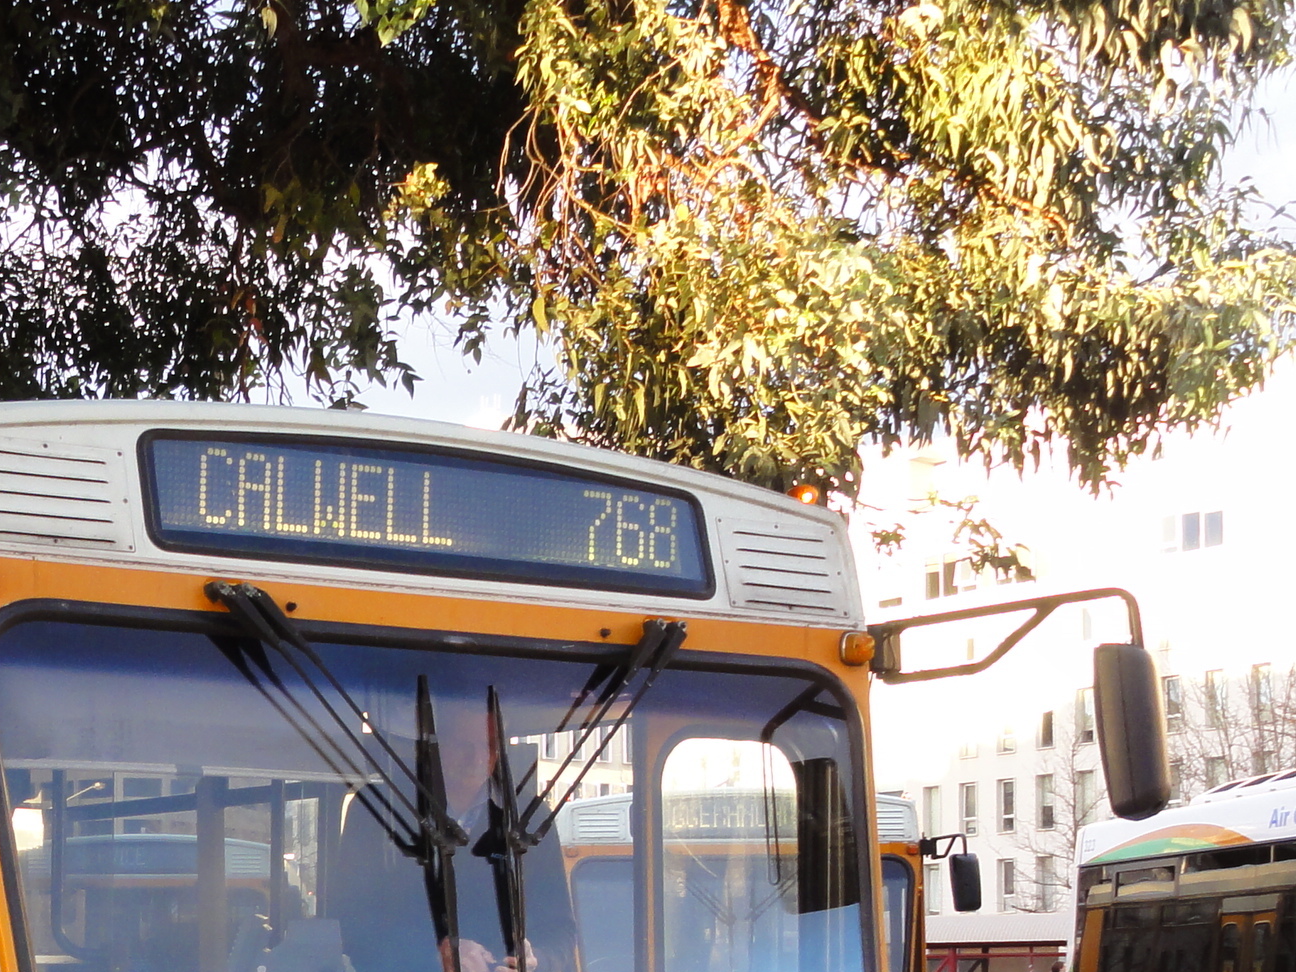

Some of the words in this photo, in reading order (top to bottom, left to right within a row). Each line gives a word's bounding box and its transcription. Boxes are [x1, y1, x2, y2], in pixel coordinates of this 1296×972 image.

[200, 447, 453, 547] CALWELL
[583, 489, 678, 568] 768
[1268, 805, 1291, 829] Air
